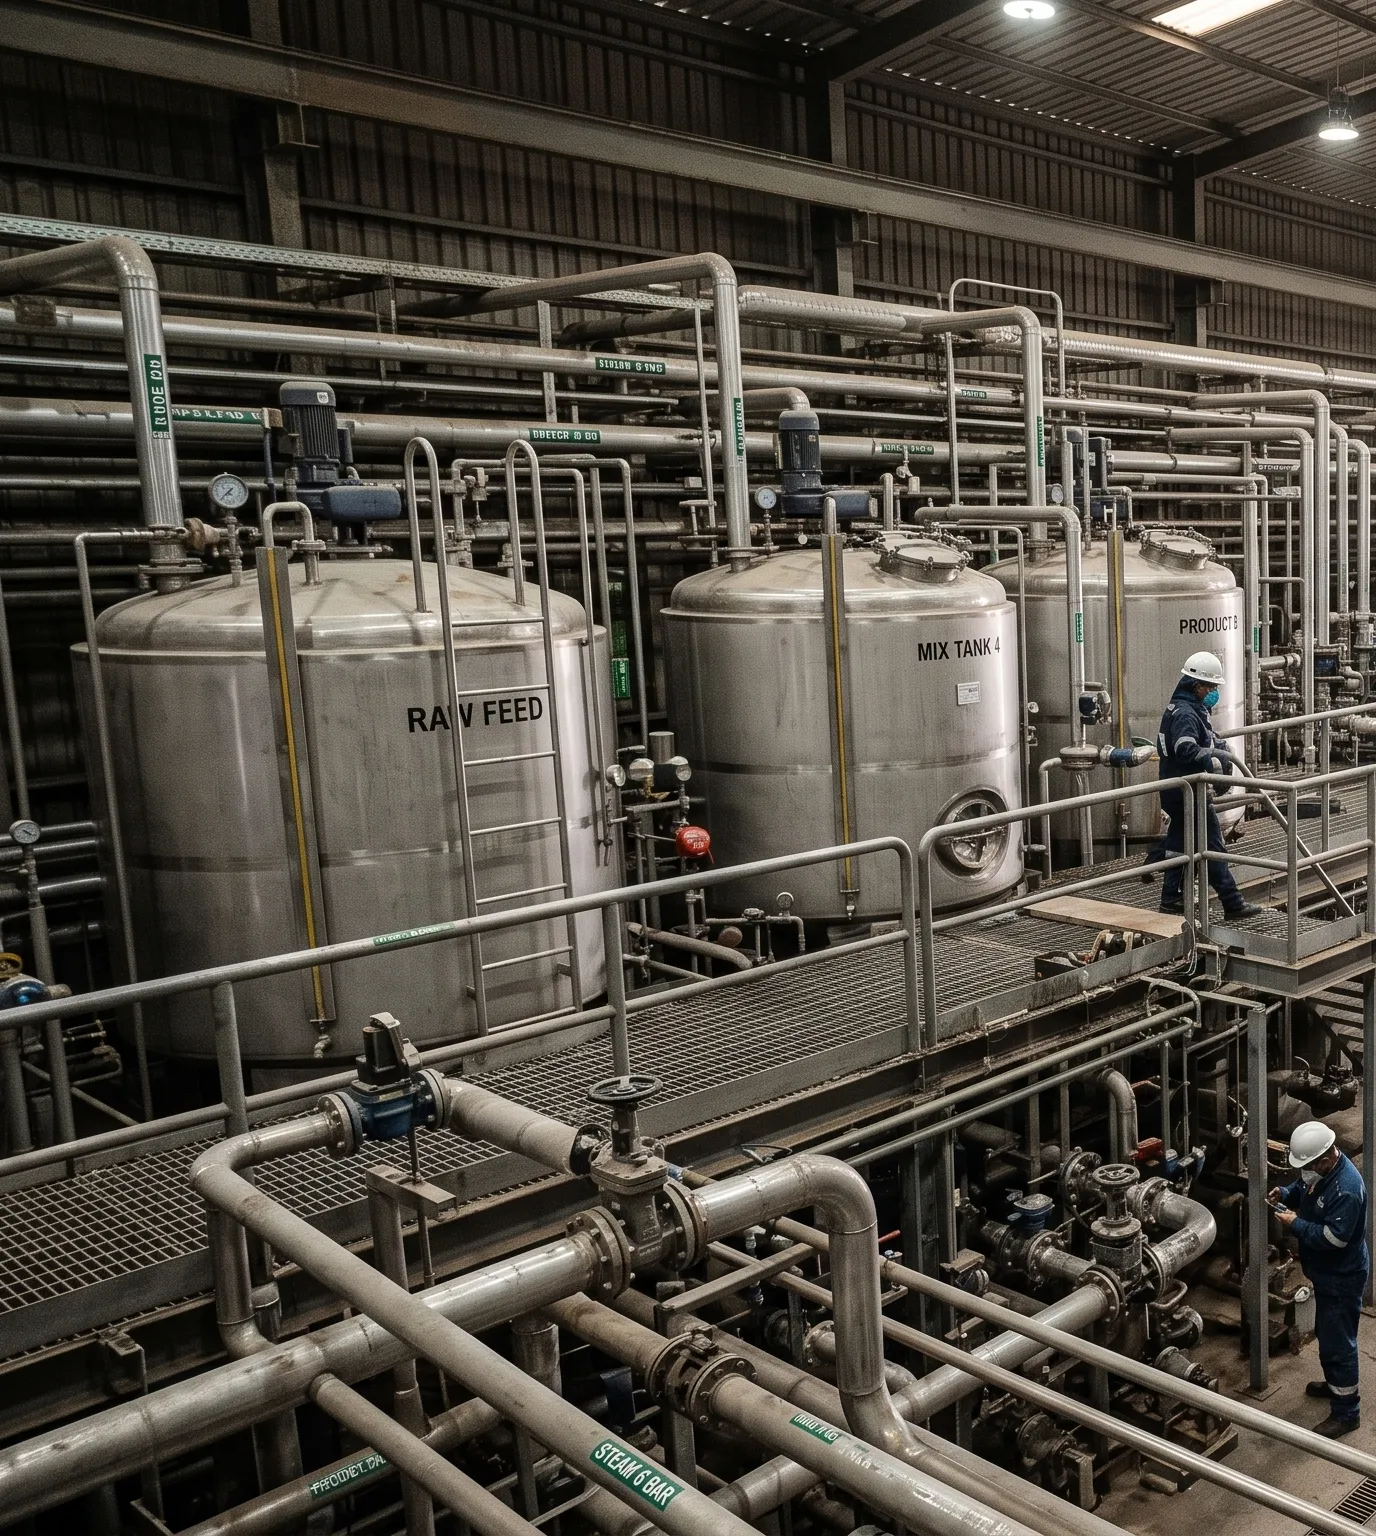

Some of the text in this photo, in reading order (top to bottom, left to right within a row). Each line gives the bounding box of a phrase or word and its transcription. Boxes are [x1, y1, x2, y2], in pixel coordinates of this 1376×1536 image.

[1179, 616, 1232, 635] PRODUCT
[917, 636, 1001, 661] MIX TANK 4
[407, 696, 543, 733] RAW FEED
[594, 1443, 675, 1506] STEAM 6 BAR
